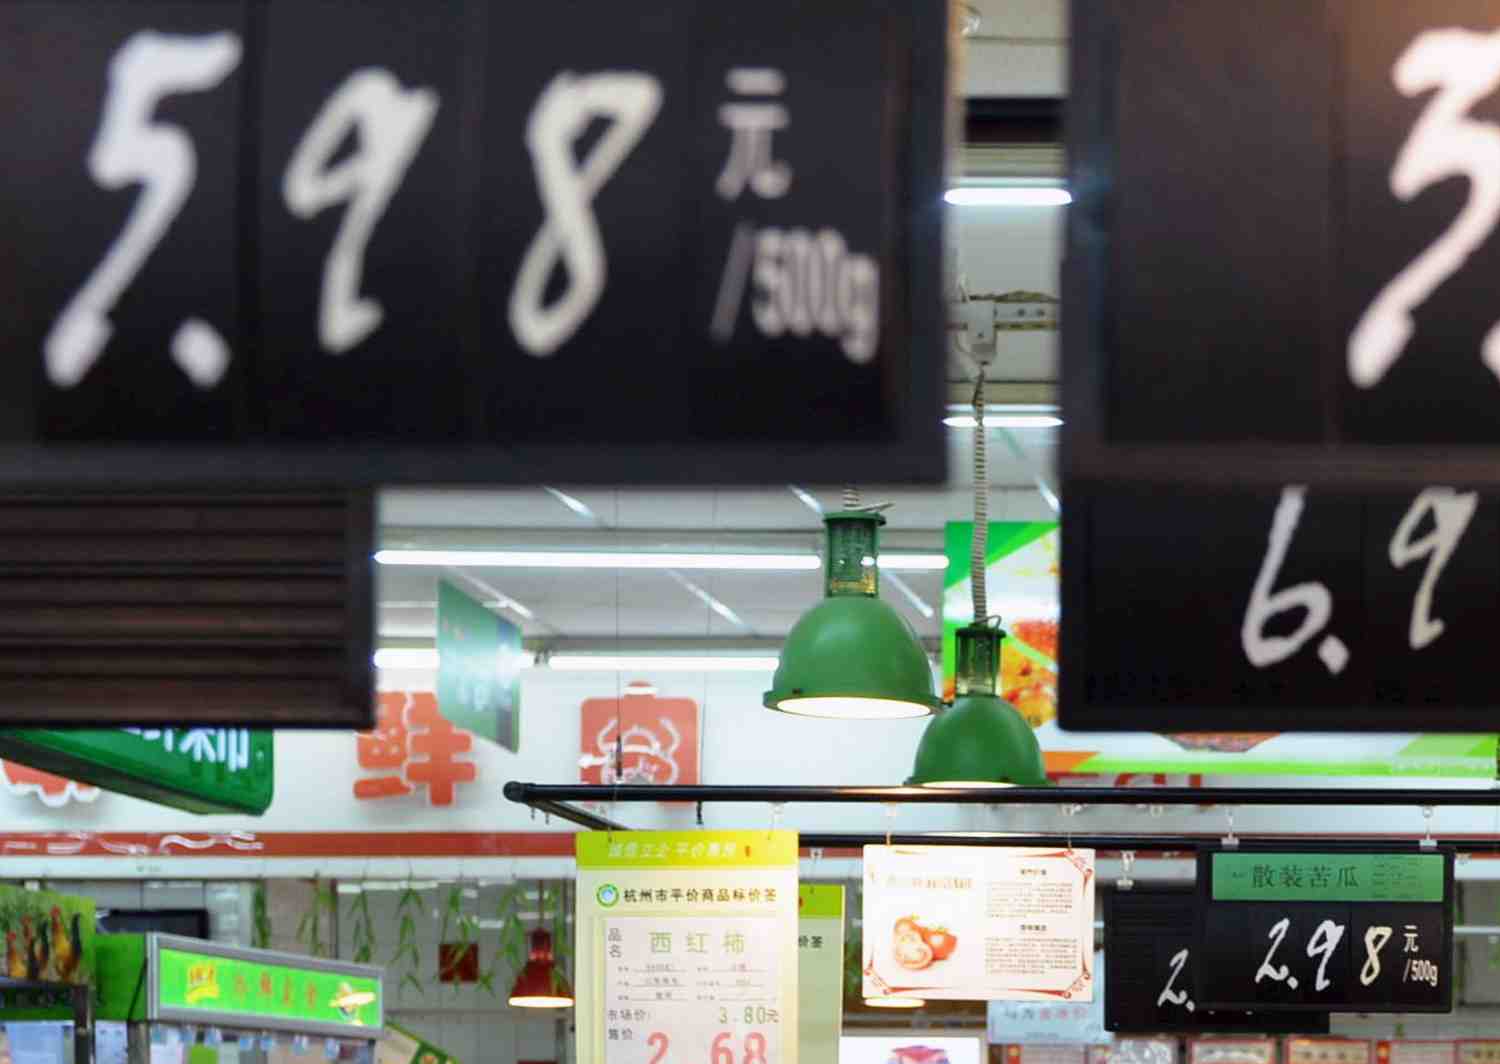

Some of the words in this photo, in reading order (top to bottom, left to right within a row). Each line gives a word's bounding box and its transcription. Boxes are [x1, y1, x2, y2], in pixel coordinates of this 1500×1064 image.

[44, 30, 662, 387] 5.98
[716, 68, 791, 199] 元
[709, 223, 880, 363] /500g
[1251, 865, 1360, 889] 散装苦瓜
[648, 930, 746, 954] 西红柿
[1254, 917, 1394, 992] 2.98
[1402, 924, 1420, 953] 元
[1402, 958, 1439, 987] /500g
